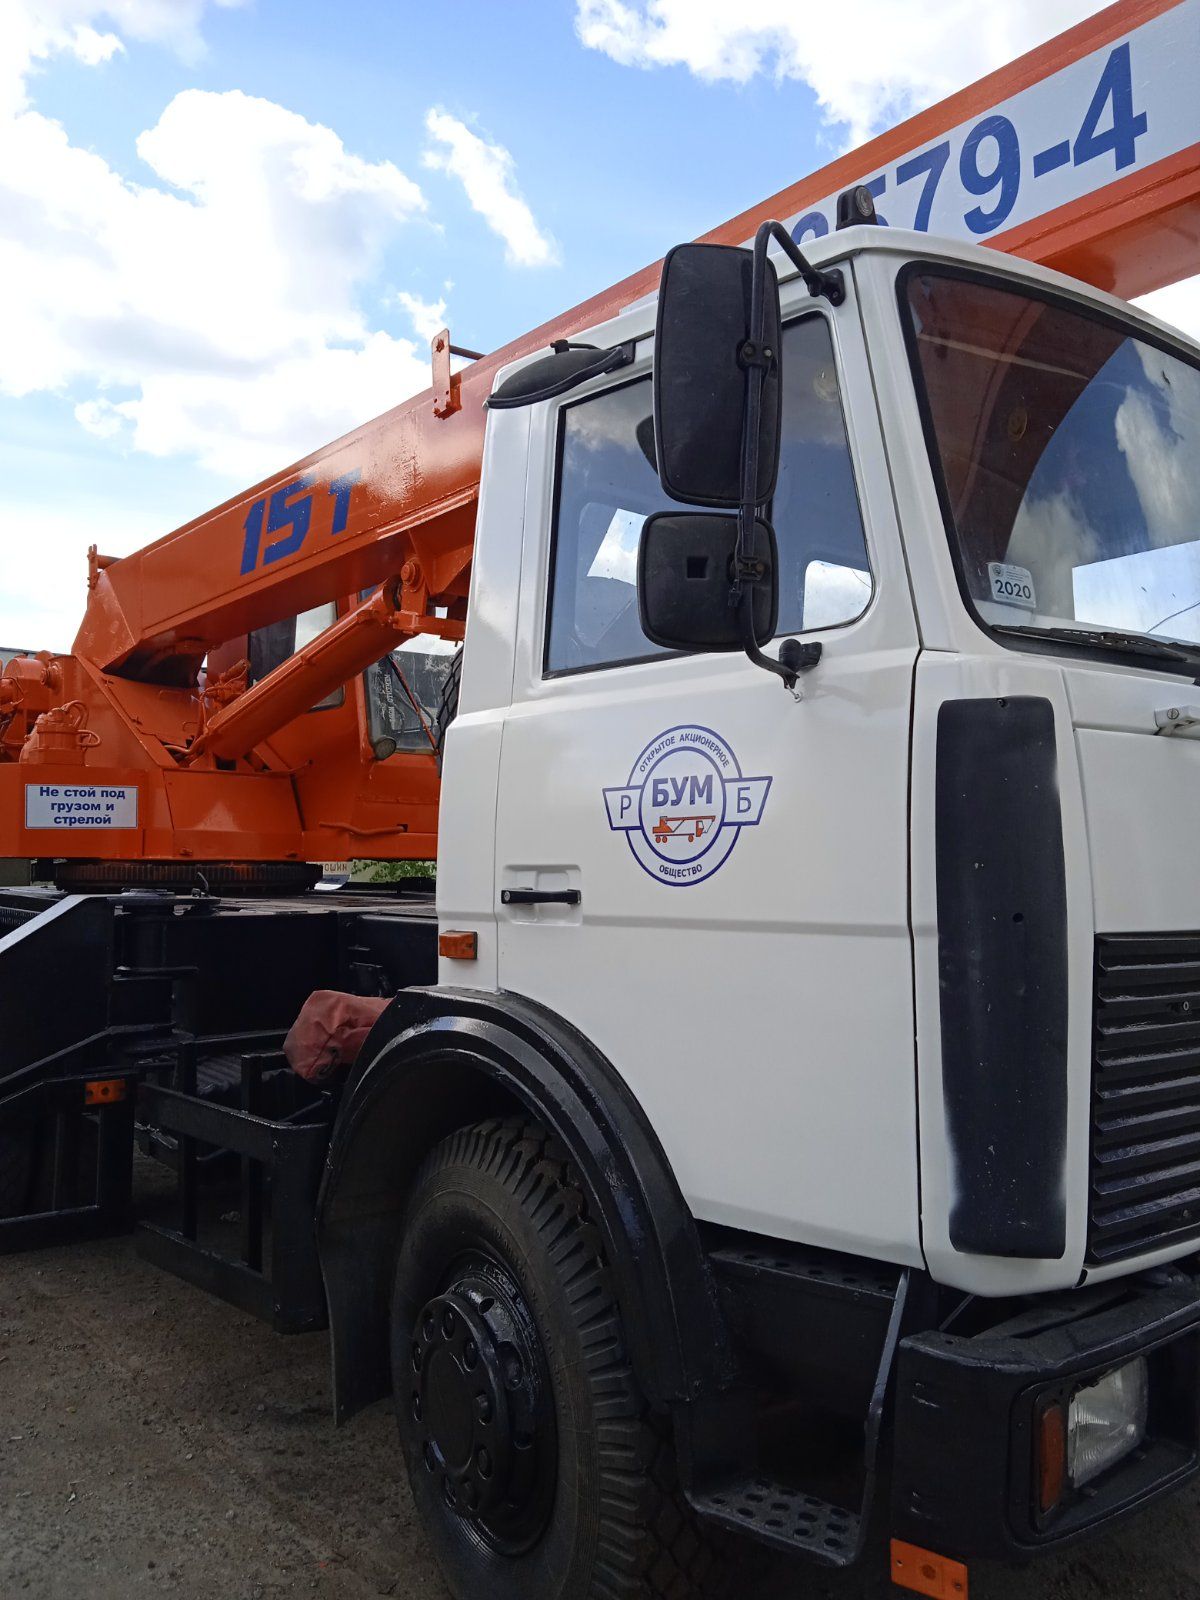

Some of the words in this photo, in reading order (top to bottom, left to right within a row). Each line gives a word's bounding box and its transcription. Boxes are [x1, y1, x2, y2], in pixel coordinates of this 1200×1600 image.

[791, 42, 1147, 245] 79-4
[995, 579, 1031, 599] 2020
[639, 736, 676, 773] ОТКРЫТОЕ
[679, 732, 730, 768] АКЦИОНЕРНОЕ
[40, 786, 59, 797] Не
[64, 787, 95, 798] стой
[101, 790, 126, 800] под
[652, 774, 713, 807] БУМ
[737, 786, 752, 813] Б
[51, 802, 101, 813] грузом
[106, 803, 115, 811] и
[620, 795, 632, 819] Р
[54, 814, 111, 826] стрелой
[659, 863, 703, 879] ОБЩЕСТВО
